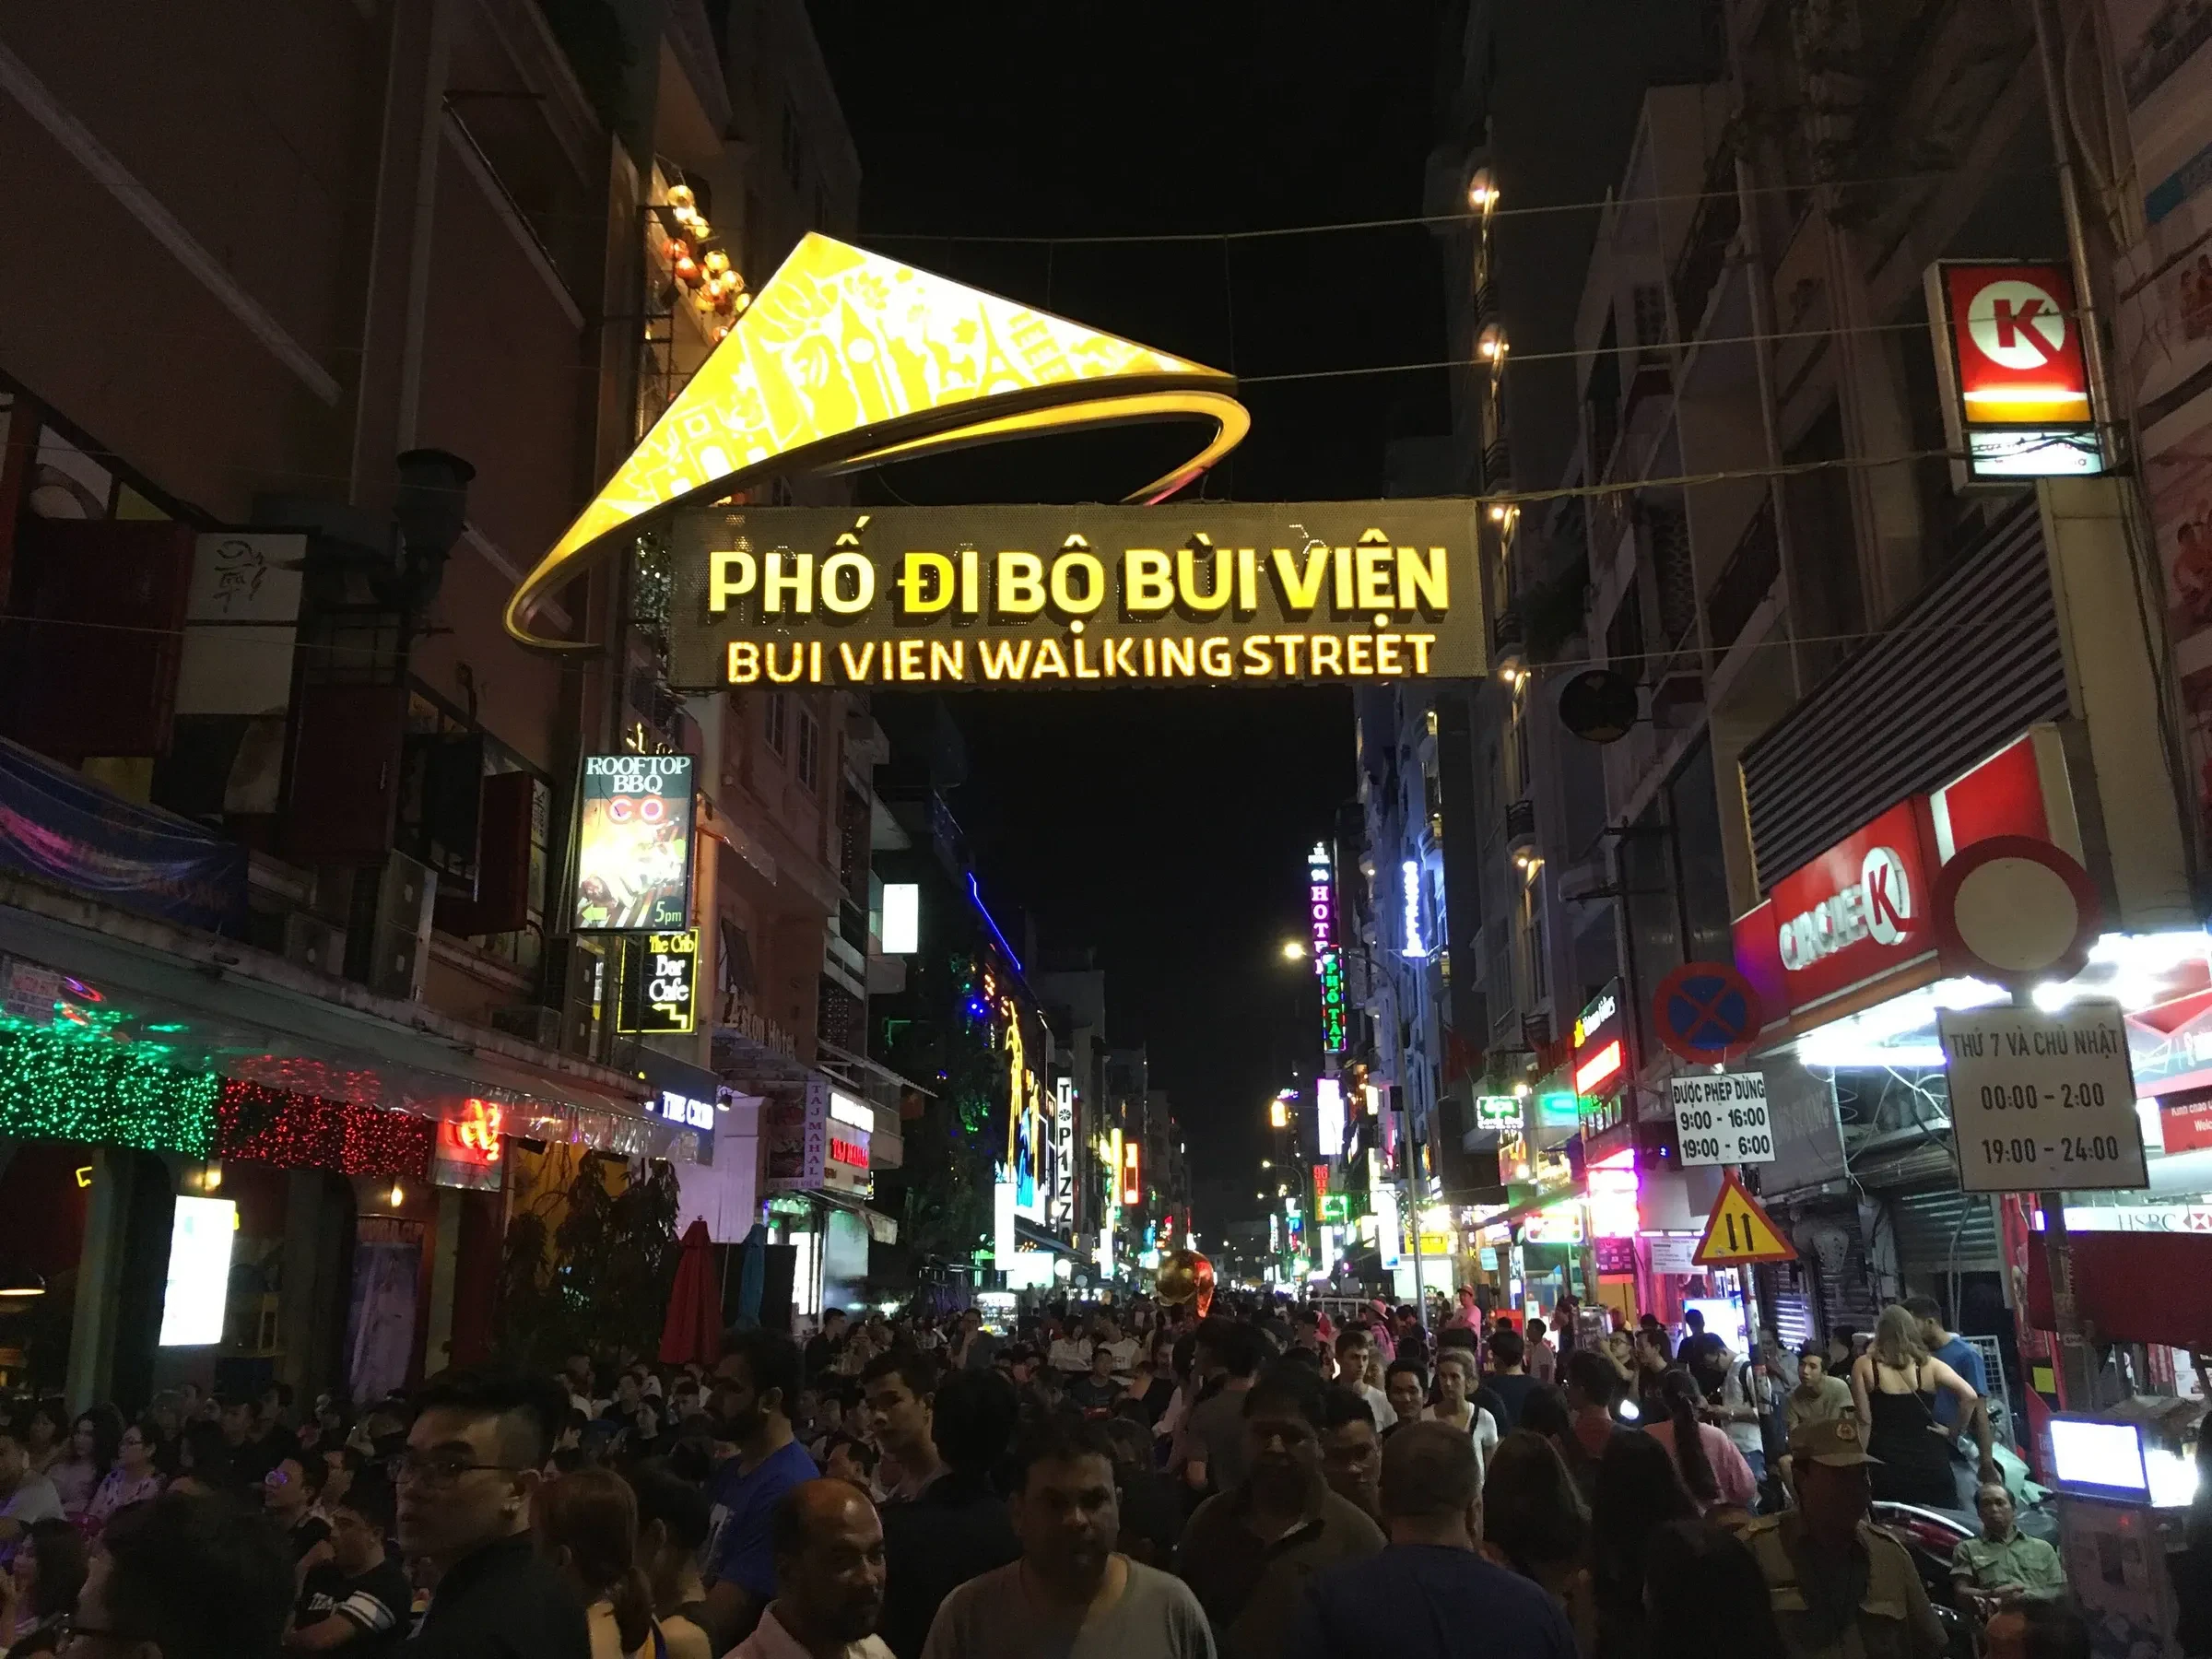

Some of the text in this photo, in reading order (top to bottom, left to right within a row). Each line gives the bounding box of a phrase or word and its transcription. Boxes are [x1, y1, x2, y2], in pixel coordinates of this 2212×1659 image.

[1991, 297, 2062, 364] K
[709, 516, 1449, 634] PHỐ ĐI BỘ BÙI VIỆN
[728, 633, 1436, 684] BUI VIEN WALKING STREET
[586, 757, 690, 775] ROOFTOP
[613, 774, 663, 794] BBQ
[654, 900, 682, 926] 5pm
[1779, 884, 1869, 971] CIRCLE
[655, 955, 686, 976] Bar
[649, 977, 689, 1002] Cafe
[1325, 963, 1342, 1048] PHỐ TÂY
[1949, 1026, 1983, 1058] THỨ
[1989, 1033, 2000, 1057] 7
[2006, 1025, 2030, 1056] VÀ
[2033, 1024, 2068, 1055] CHỦ
[2074, 1022, 2119, 1059] NHẬT
[1673, 1081, 1703, 1108] ĐƯỢC
[1705, 1077, 1732, 1101] PHÉP
[1981, 1085, 2038, 1110] 00:00
[2060, 1082, 2105, 1109] 2:00
[807, 1085, 823, 1175] TAJ MAHAL
[1680, 1110, 1712, 1131] 9:00
[1727, 1107, 1766, 1128] 16:00
[832, 1137, 846, 1161] TAJ
[1682, 1137, 1719, 1159] 19:00
[1738, 1135, 1771, 1156] 6:00
[1982, 1137, 2037, 1164] 19:00
[2060, 1135, 2120, 1162] 24:00
[1313, 1165, 1328, 1180] 96
